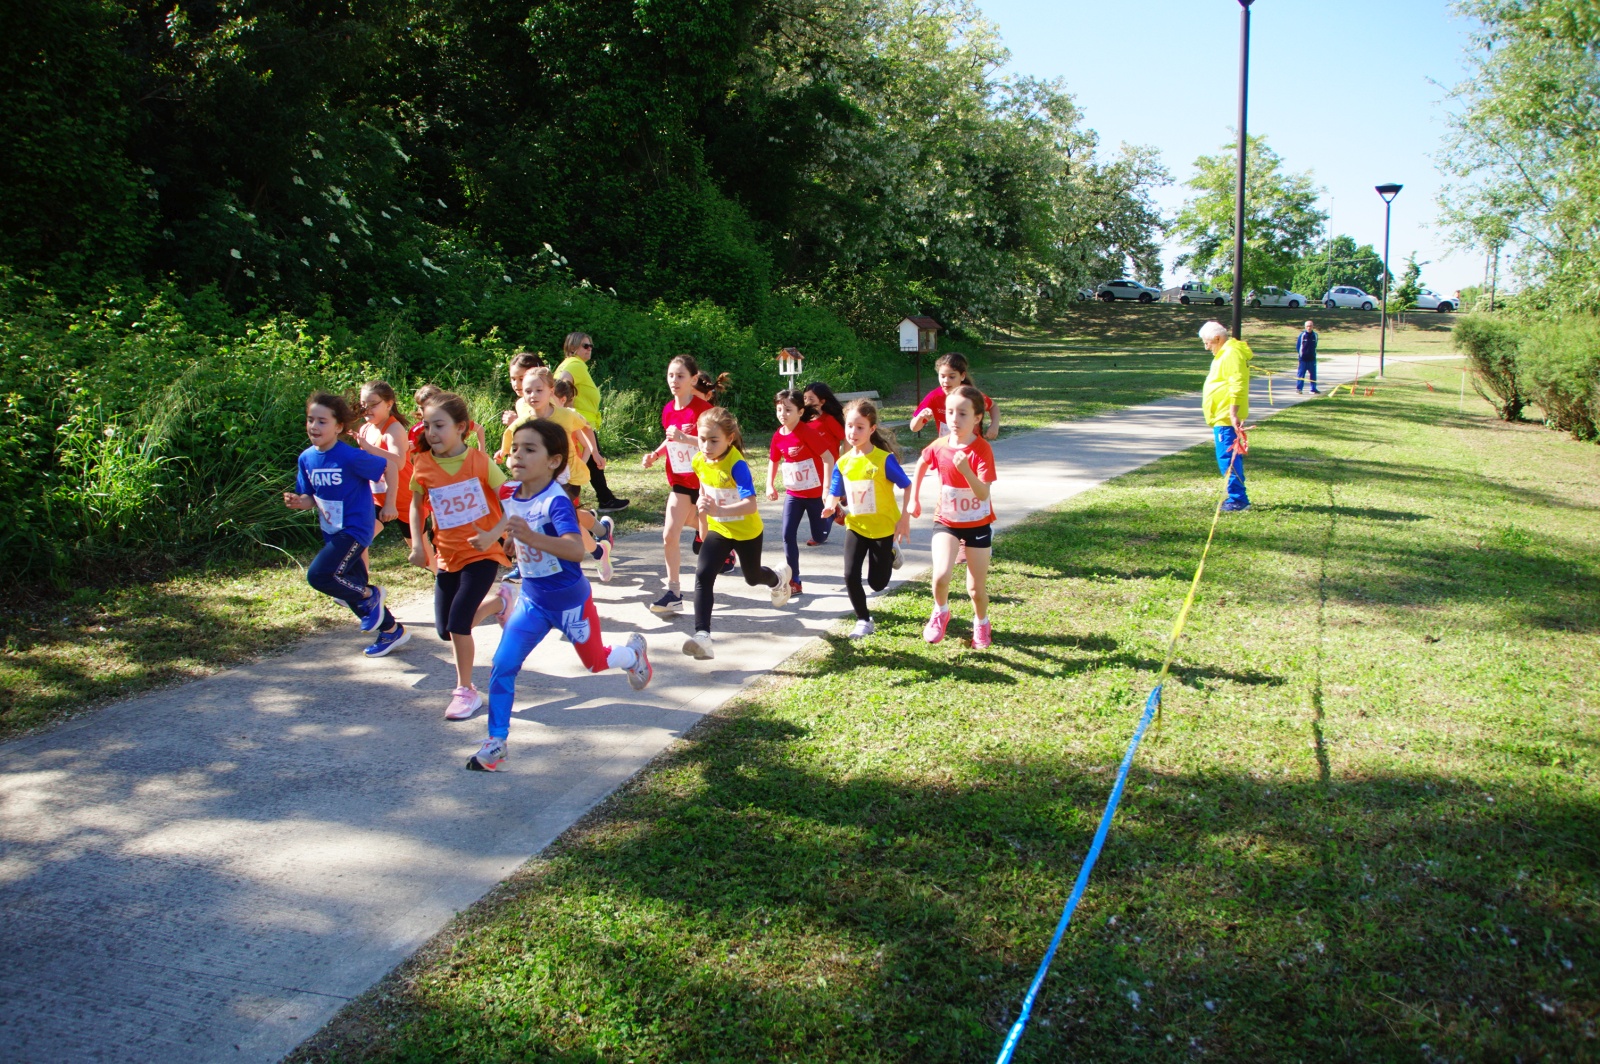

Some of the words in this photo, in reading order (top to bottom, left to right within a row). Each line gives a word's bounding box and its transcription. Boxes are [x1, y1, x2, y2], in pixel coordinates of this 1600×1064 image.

[677, 450, 691, 463] 91
[305, 468, 343, 487] VANS
[790, 468, 810, 483] 107
[440, 492, 478, 516] 252
[950, 497, 981, 513] 108
